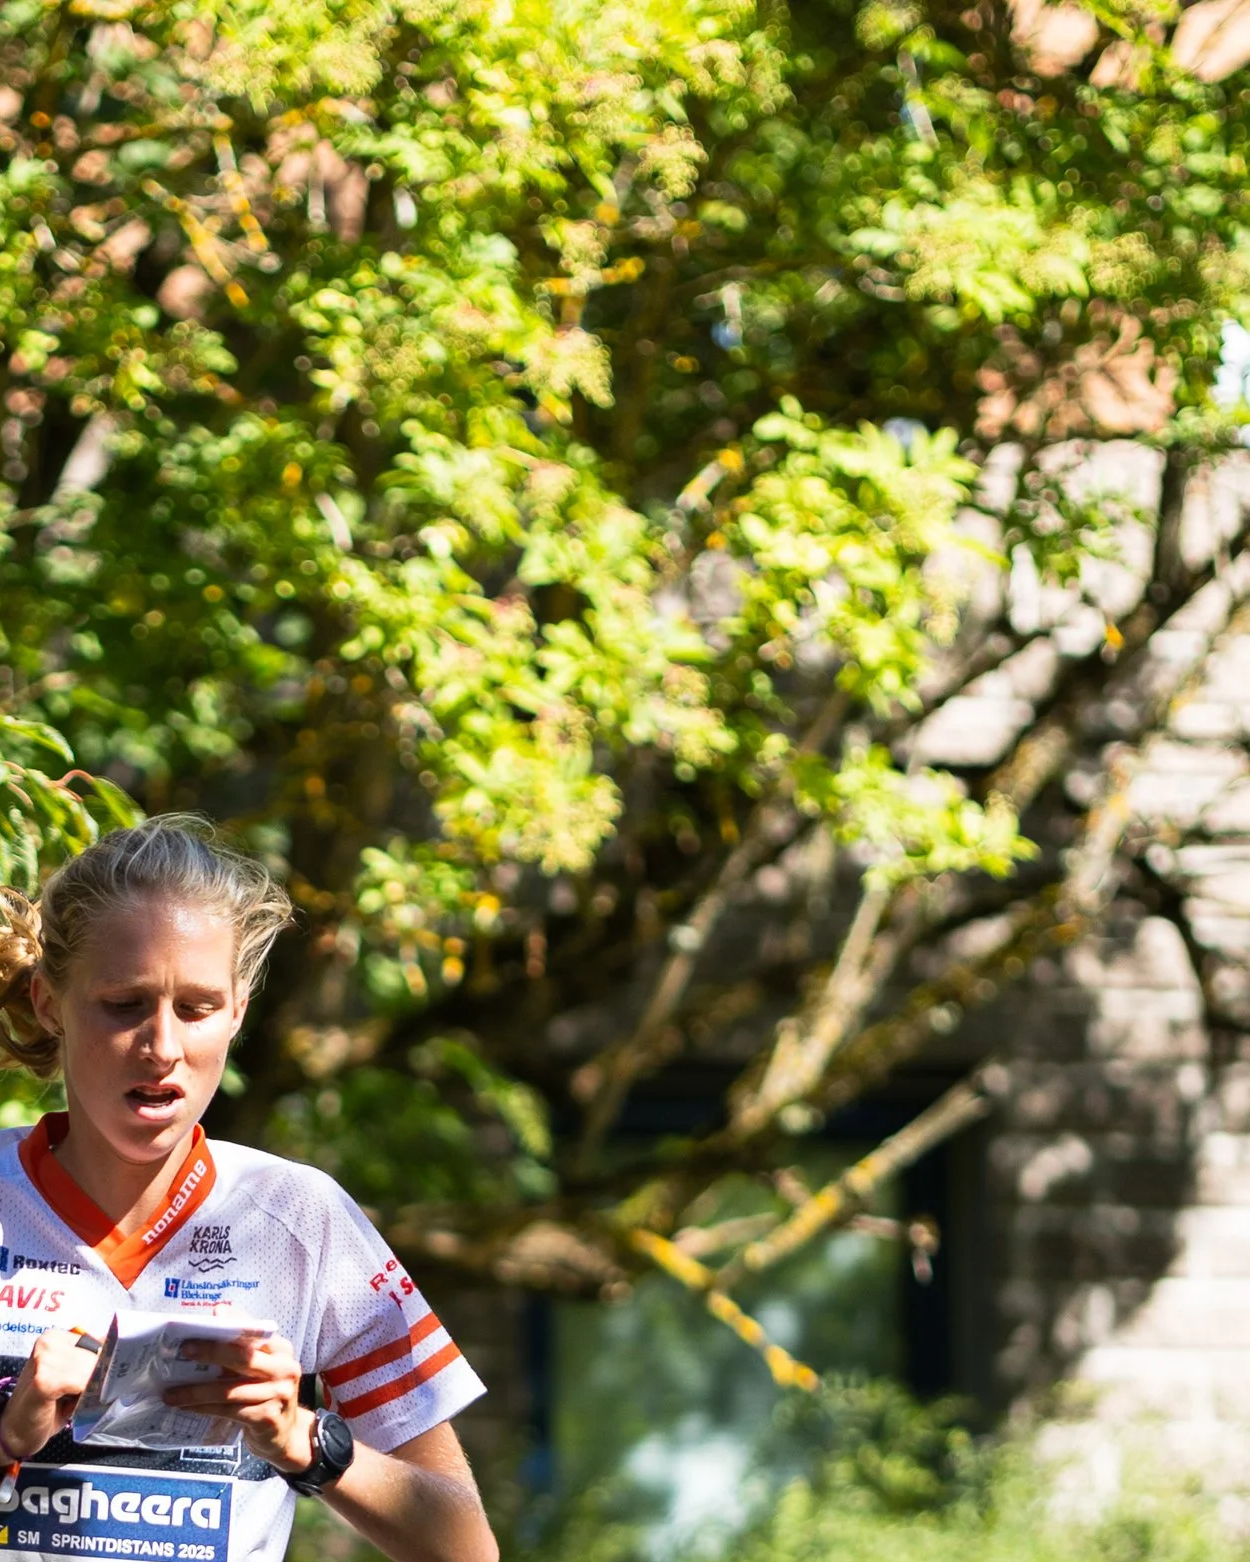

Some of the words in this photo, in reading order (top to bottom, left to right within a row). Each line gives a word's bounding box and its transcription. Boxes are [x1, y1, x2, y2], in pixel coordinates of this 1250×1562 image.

[142, 1158, 207, 1245] noname
[193, 1225, 232, 1240] KARLS
[189, 1239, 233, 1255] KRONA
[12, 1254, 81, 1275] Roxtec
[18, 1531, 40, 1545] SM
[52, 1534, 174, 1557] SPRINTDISTANS
[177, 1543, 215, 1560] 2025
